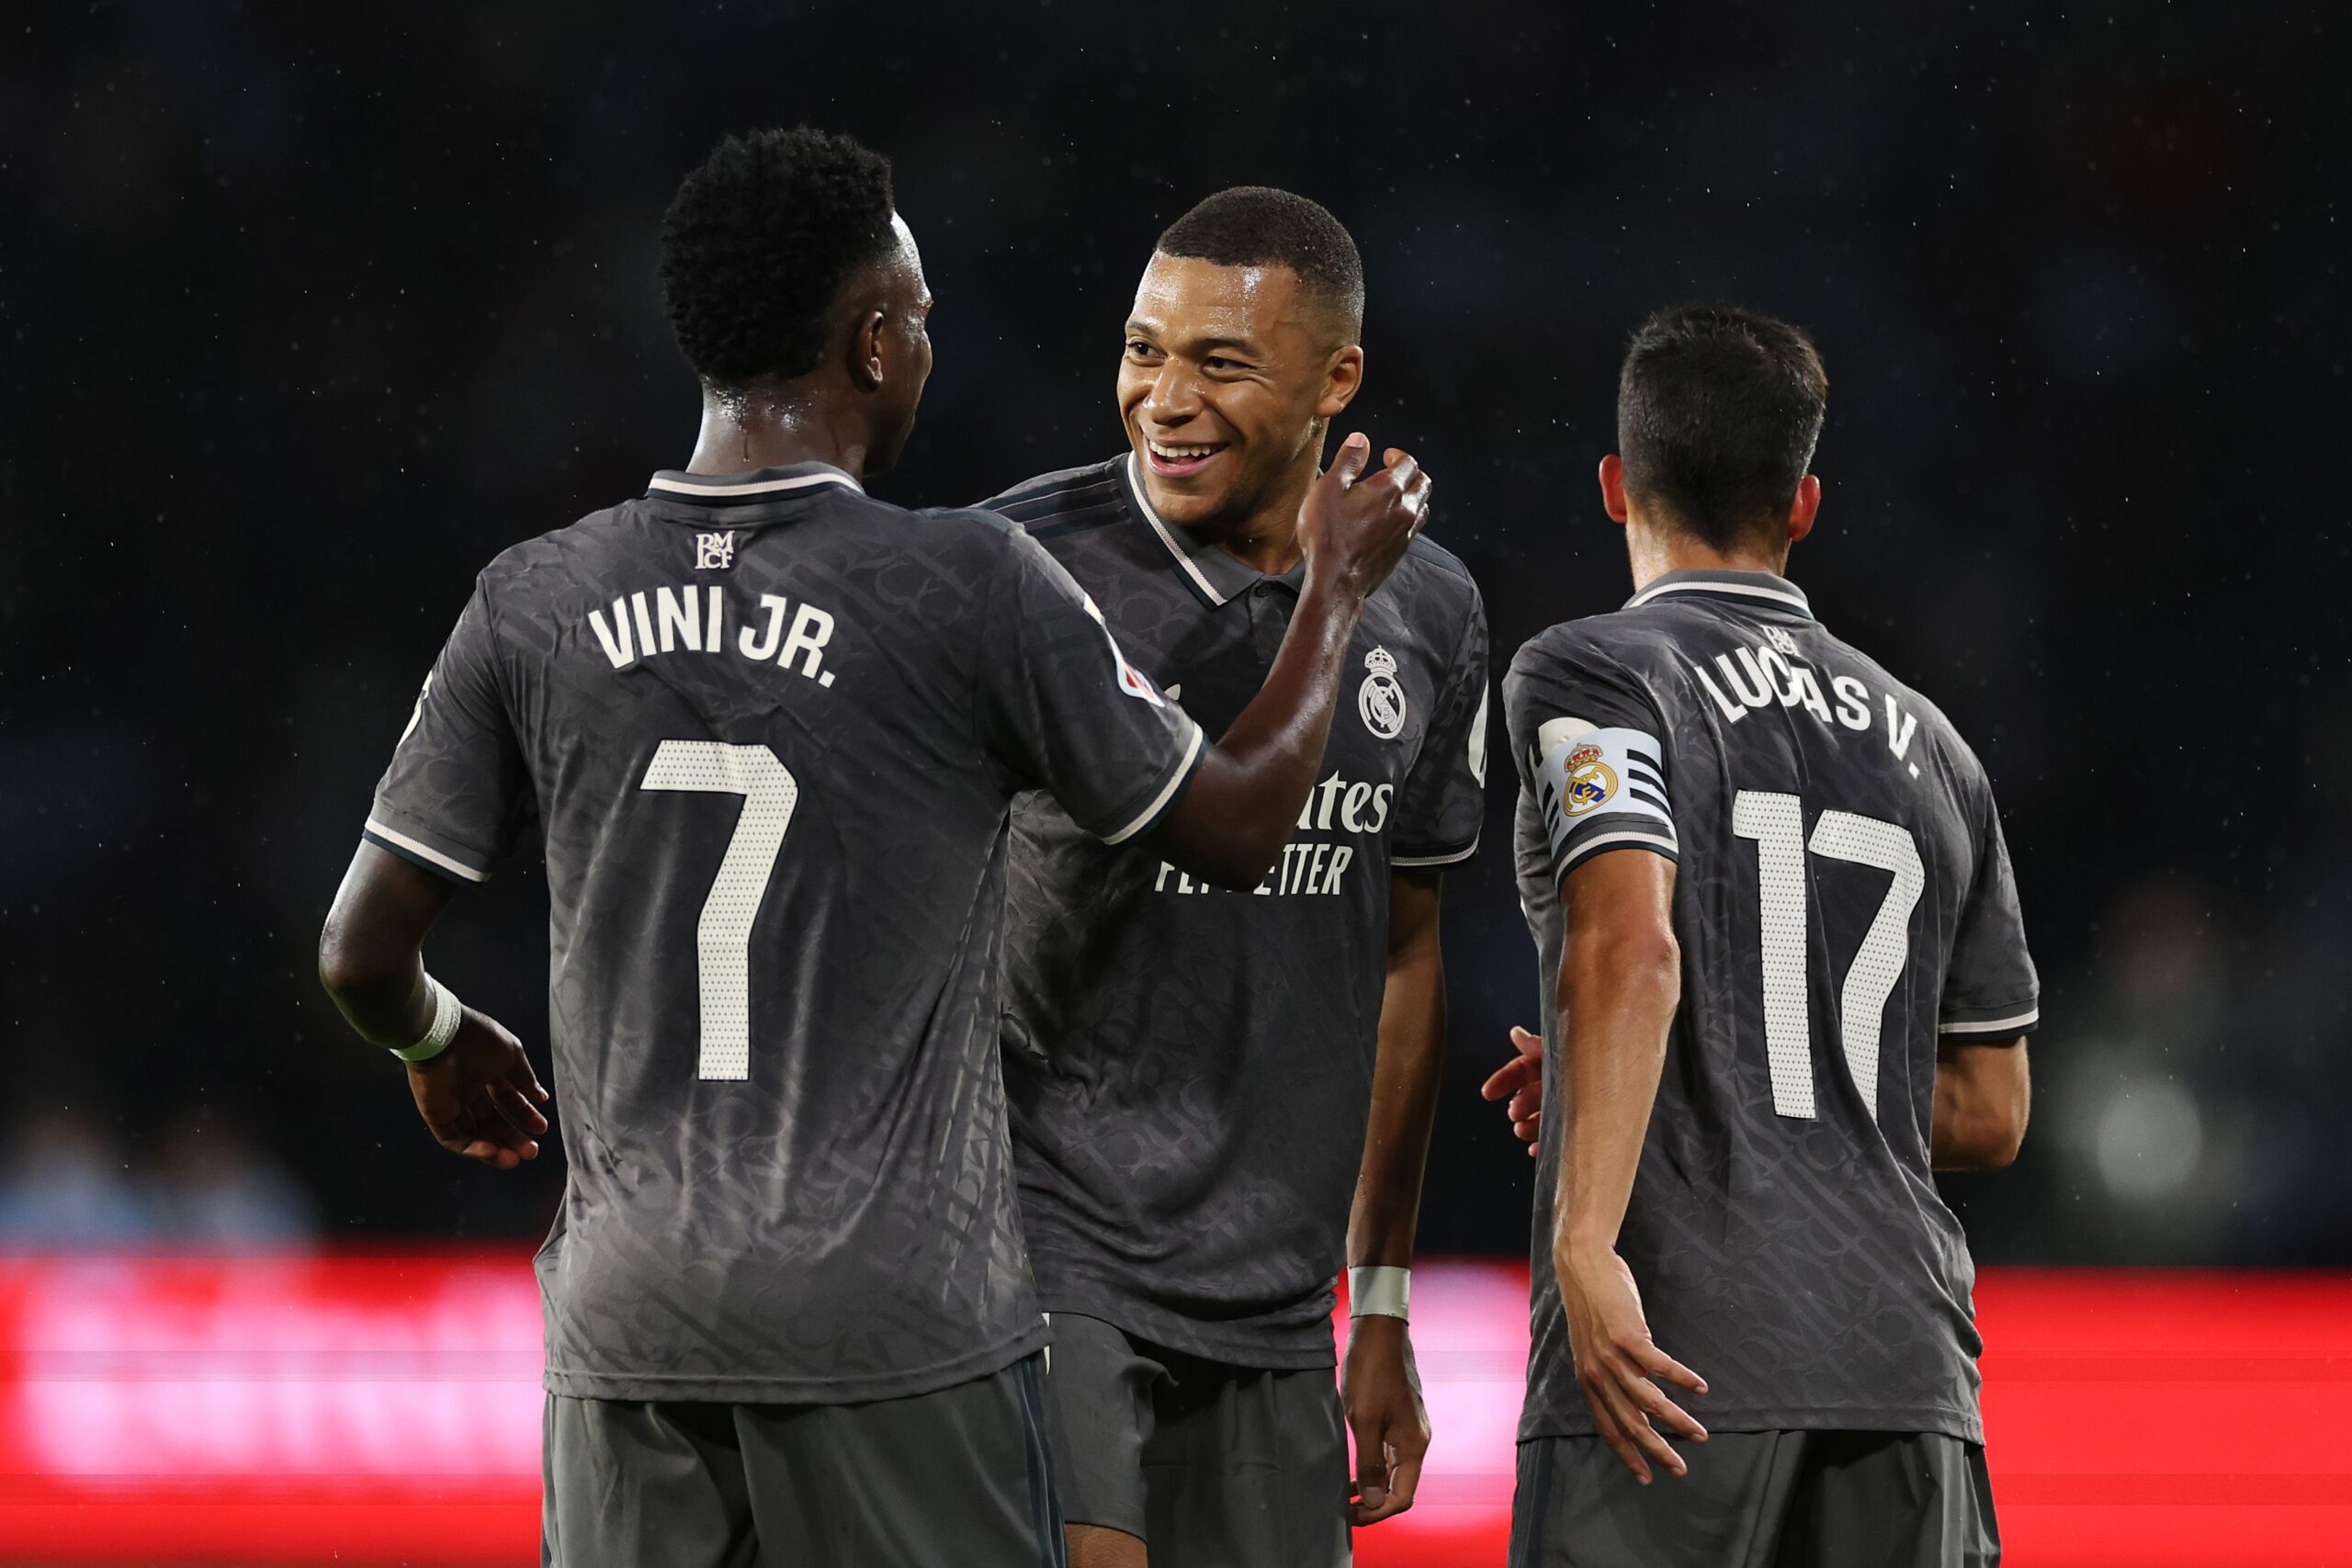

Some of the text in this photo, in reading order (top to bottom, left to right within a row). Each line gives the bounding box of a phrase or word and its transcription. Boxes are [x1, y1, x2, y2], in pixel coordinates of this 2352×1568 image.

[588, 585, 835, 688] VINI JR.
[1695, 646, 1920, 780] LUCAS V.
[640, 739, 798, 1079] 7
[1732, 788, 1925, 1126] 17
